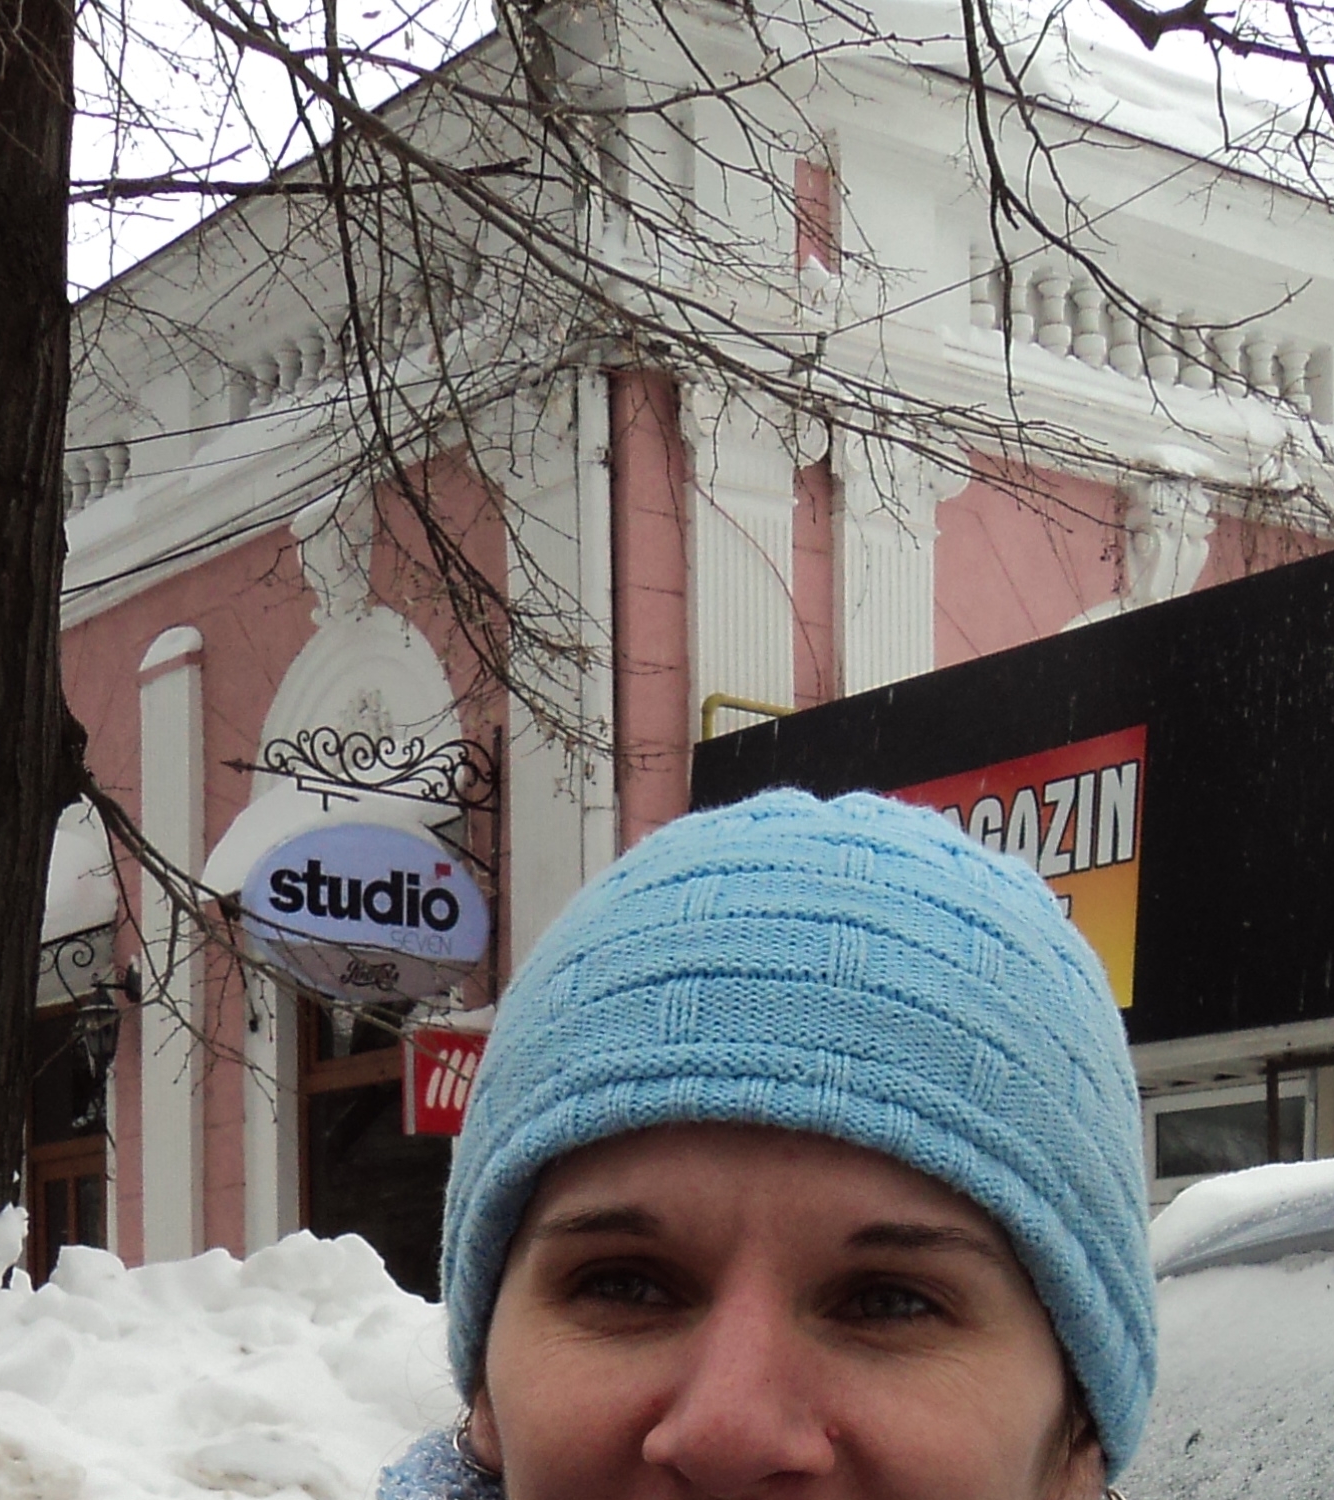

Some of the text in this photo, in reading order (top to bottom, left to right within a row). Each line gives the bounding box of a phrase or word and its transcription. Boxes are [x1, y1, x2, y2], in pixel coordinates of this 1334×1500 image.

[269, 859, 460, 932] studio
[390, 930, 454, 956] SEVEN
[425, 1048, 477, 1111] ill
